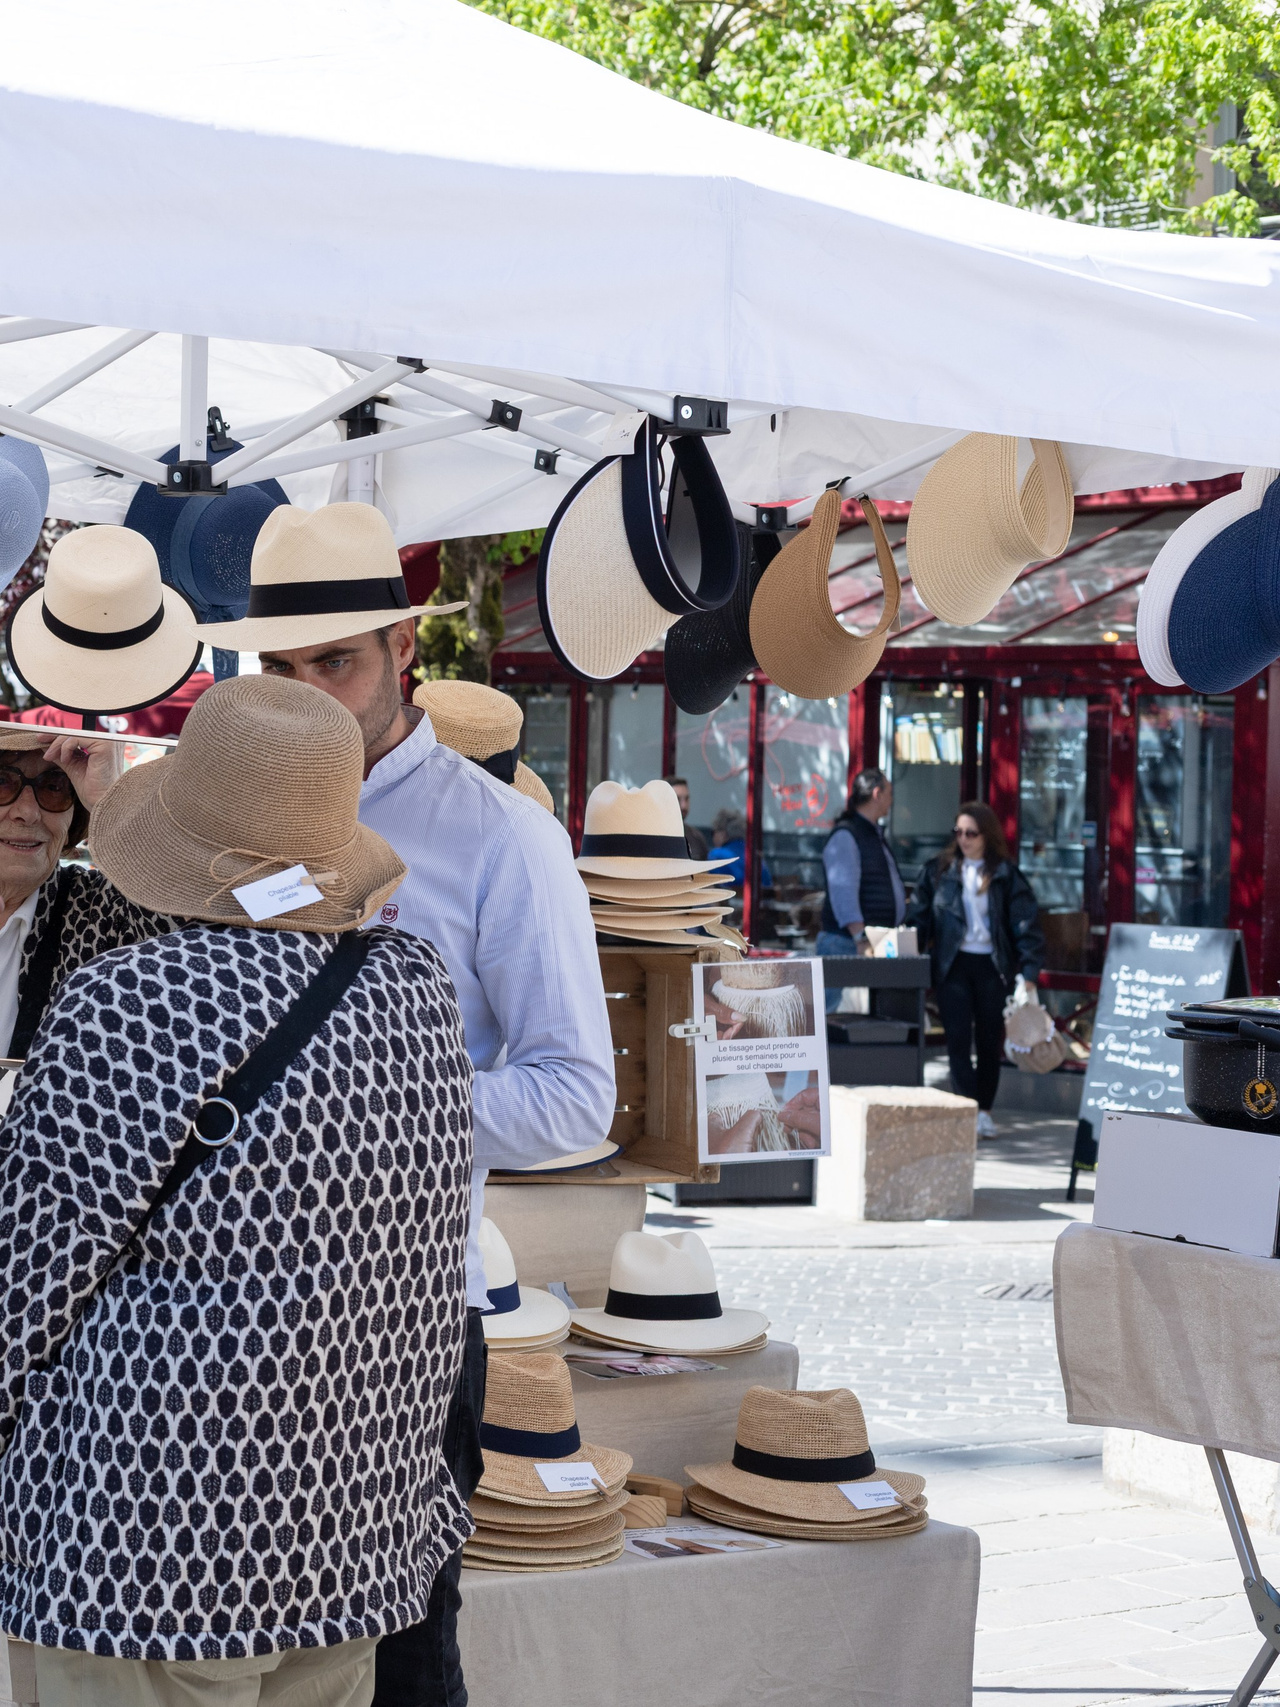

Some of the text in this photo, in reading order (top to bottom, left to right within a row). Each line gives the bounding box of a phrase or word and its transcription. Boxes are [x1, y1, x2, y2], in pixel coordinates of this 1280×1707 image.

[278, 891, 299, 903] pliable
[718, 1042, 800, 1053] Le tissage peut prendre
[712, 1055, 743, 1063] plusieurs
[744, 1052, 778, 1060] semaines
[780, 1052, 796, 1060] pour
[752, 1062, 783, 1070] chapeau
